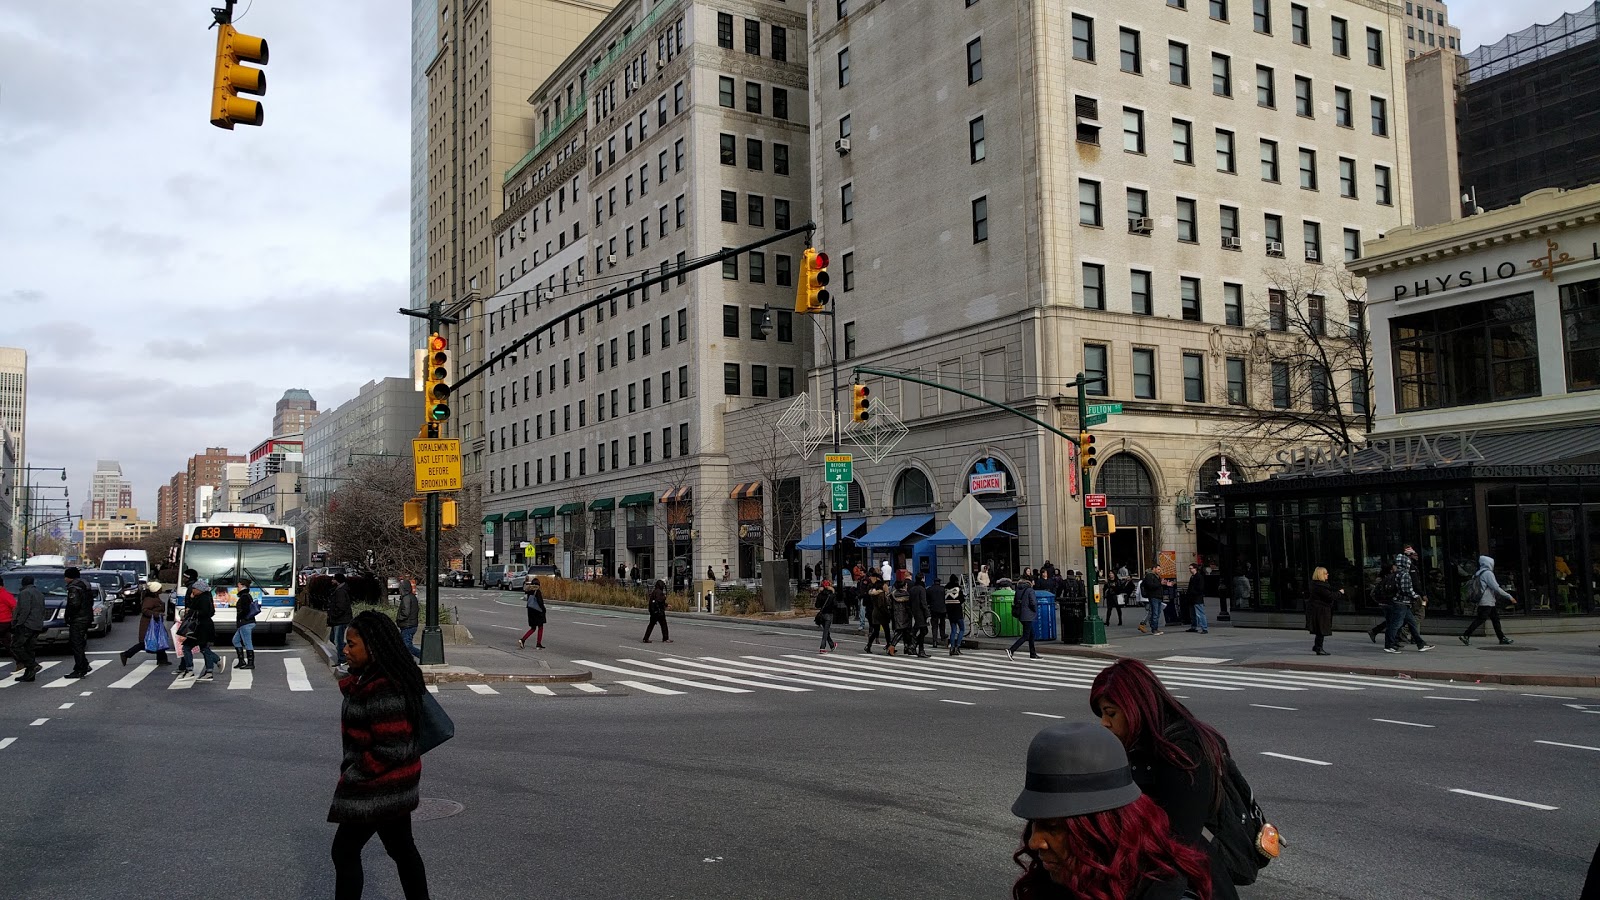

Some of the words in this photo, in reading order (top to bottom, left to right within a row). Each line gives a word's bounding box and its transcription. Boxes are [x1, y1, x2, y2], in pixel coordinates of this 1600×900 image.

[1394, 261, 1516, 301] PHYSIO
[1088, 405, 1112, 414] FULTON
[418, 443, 448, 451] JORALEMON
[451, 443, 457, 451] ST
[1275, 442, 1363, 475] SHAKE
[1372, 430, 1485, 469] SHACK
[417, 455, 429, 464] LAST
[432, 455, 444, 463] LEFT
[446, 454, 458, 463] TURN
[429, 467, 449, 475] BEFORE
[1421, 465, 1466, 481] FLOATS
[1474, 465, 1553, 476] CONCRETES
[421, 479, 447, 488] BROOKLYN
[450, 478, 456, 486] BR
[973, 478, 999, 490] CHICKEN
[201, 527, 220, 538] B38
